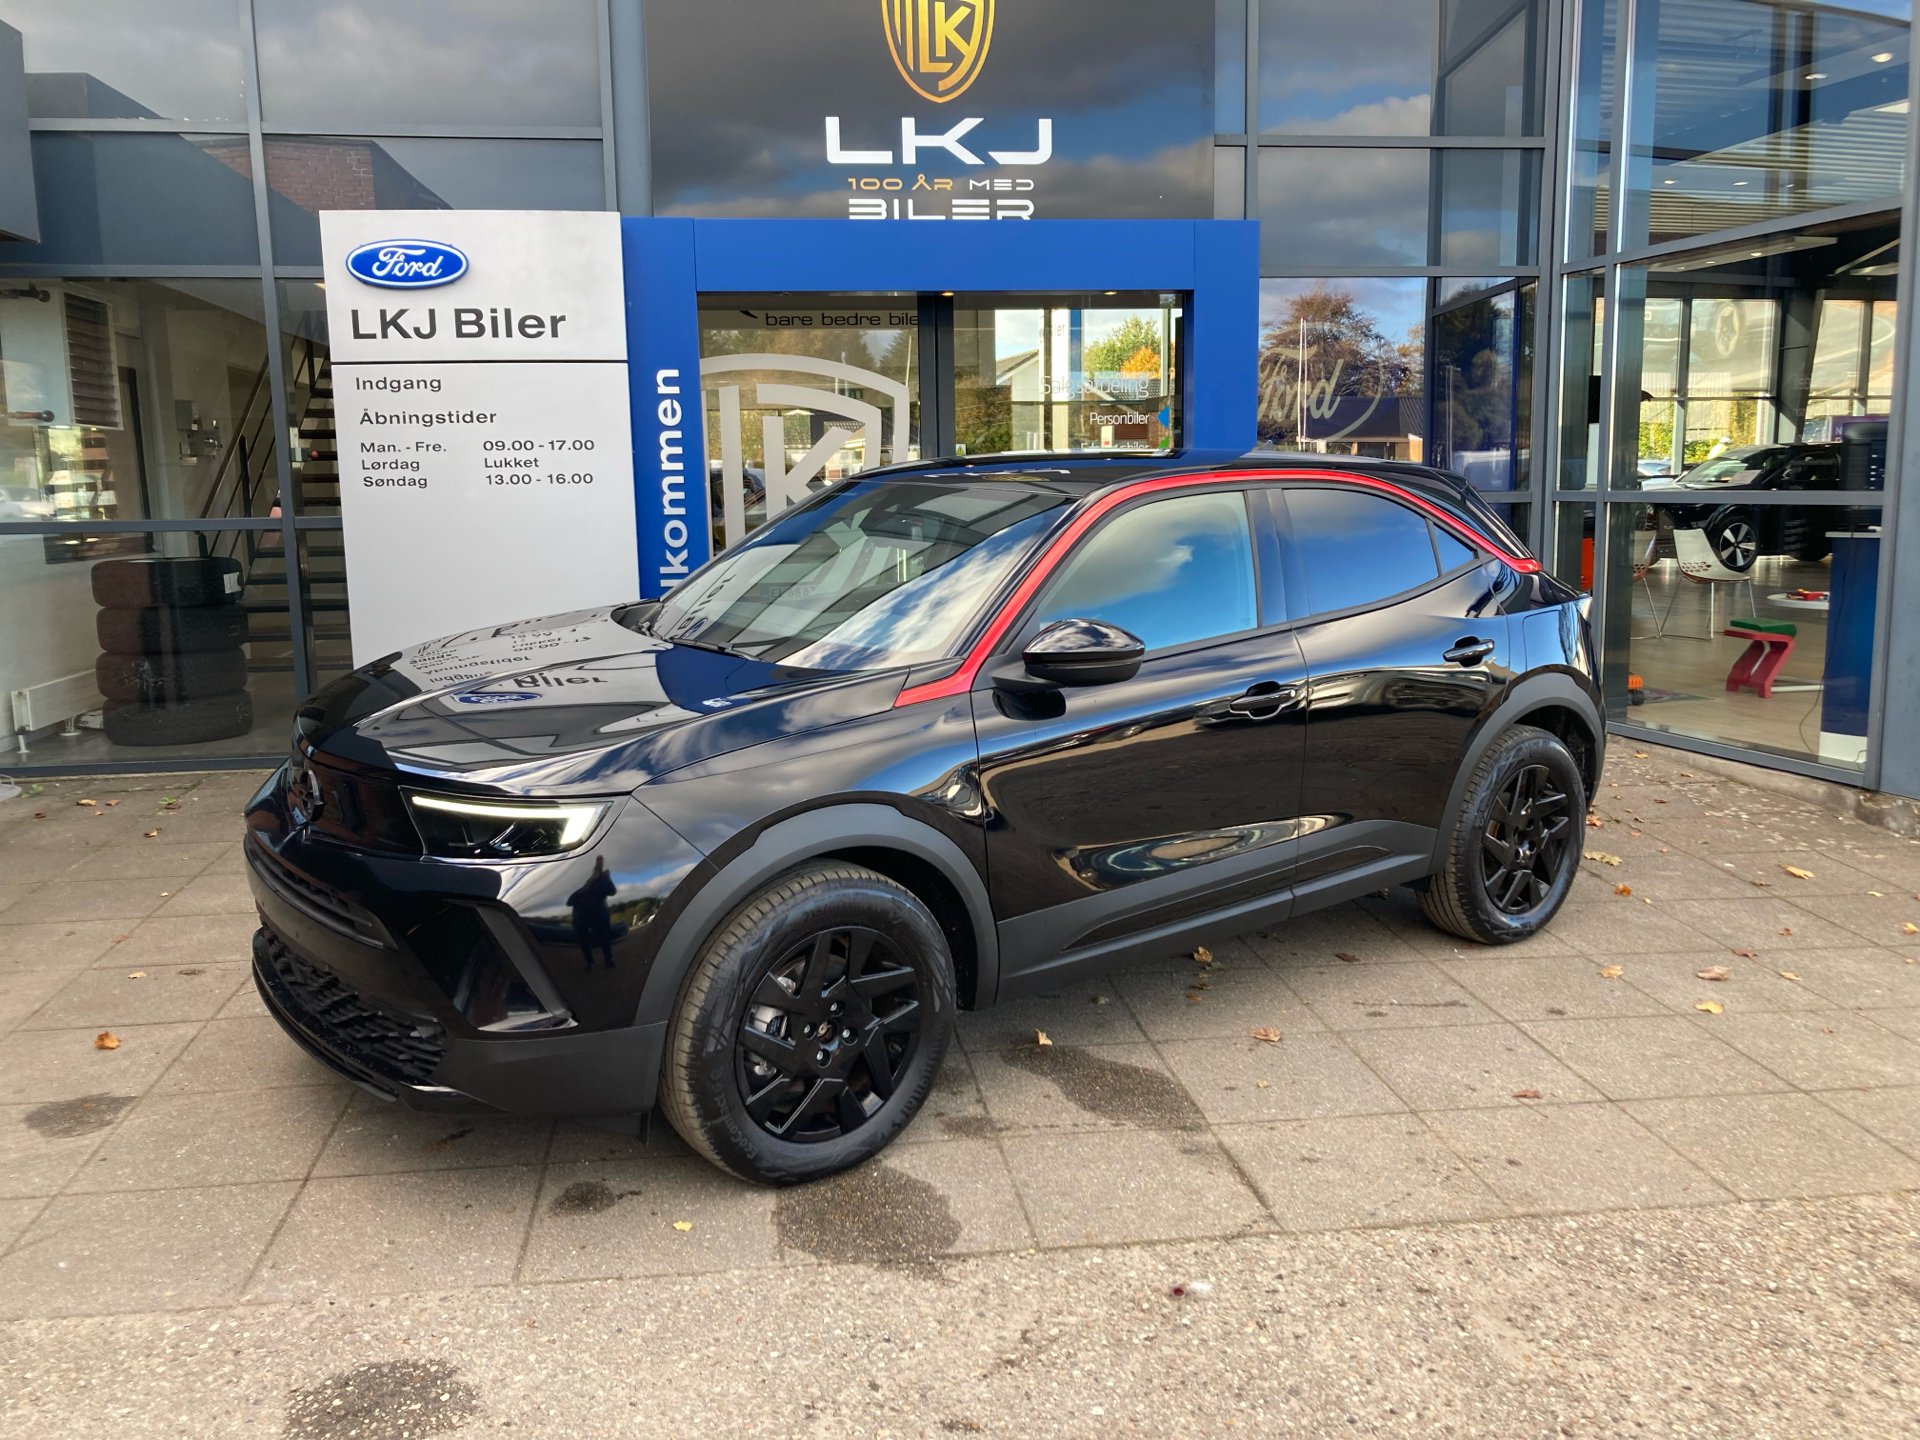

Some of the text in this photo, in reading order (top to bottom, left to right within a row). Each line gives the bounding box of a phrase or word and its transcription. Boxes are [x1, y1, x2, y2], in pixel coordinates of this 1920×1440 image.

[826, 116, 1053, 165] LKJ
[848, 177, 903, 190] 100
[911, 173, 953, 190] ÅR
[848, 198, 1035, 220] BILER
[371, 246, 443, 278] Ford
[351, 307, 567, 340] LKJ Biler
[765, 312, 919, 326] bare bedre bile
[356, 376, 442, 393] Indgang
[359, 407, 497, 427] Åbningstider
[1089, 410, 1150, 425] Personbiler
[360, 442, 402, 453] Man.
[415, 441, 447, 452] Fre.
[483, 439, 534, 451] 09.00
[548, 439, 595, 450] 17.00
[362, 457, 540, 472] Lørdag Lukket
[363, 475, 428, 489] Søndag
[485, 473, 532, 485] 13.00
[547, 472, 594, 484] 16.00
[656, 368, 690, 590] lkommen
